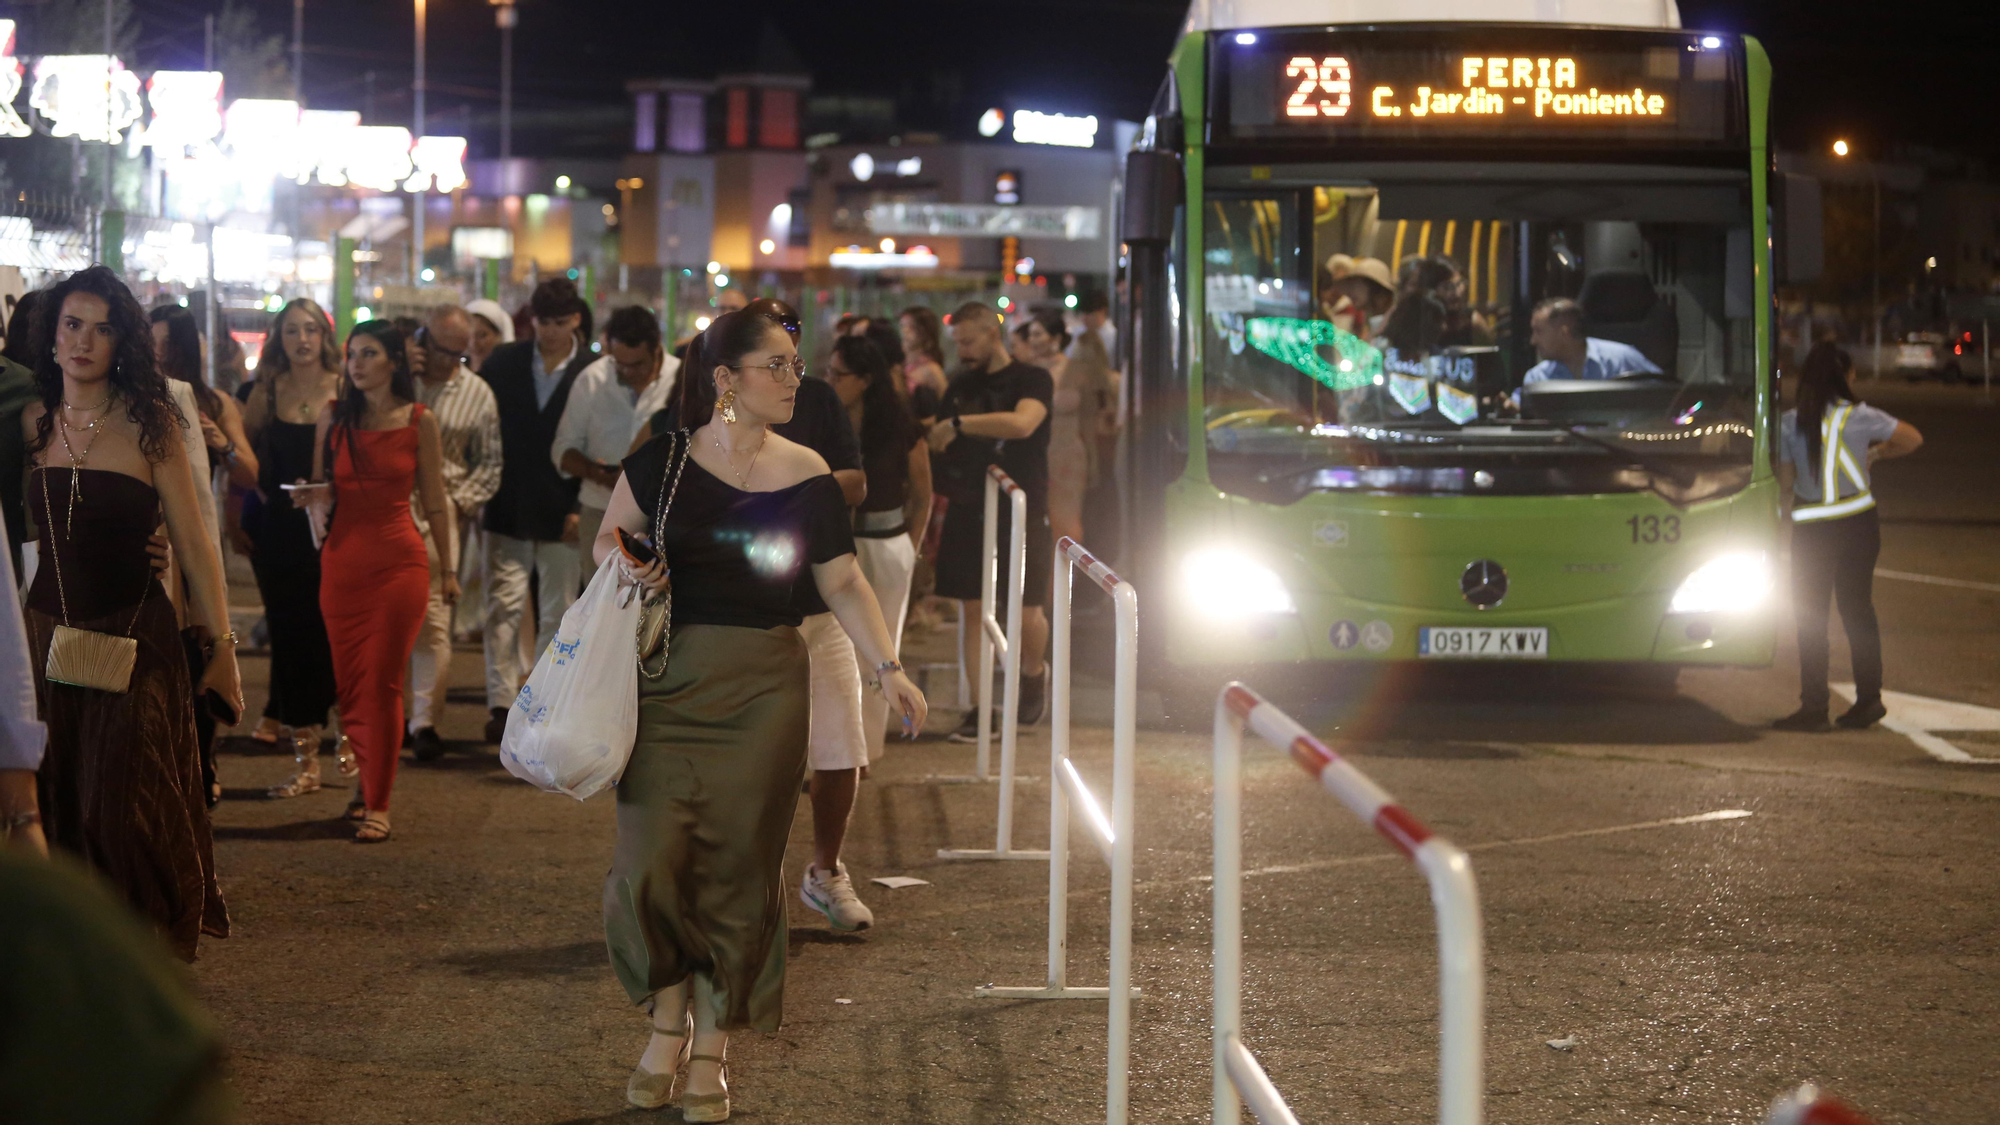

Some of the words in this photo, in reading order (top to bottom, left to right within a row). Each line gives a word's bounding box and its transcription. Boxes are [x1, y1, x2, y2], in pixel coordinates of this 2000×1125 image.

[1286, 56, 1351, 117] 29
[1462, 57, 1575, 88] FERIA
[1372, 86, 1401, 117] C.
[1535, 87, 1665, 117] Poniente
[1626, 514, 1682, 543] 133
[1434, 631, 1492, 652] 0917
[1500, 631, 1542, 652] KWV
